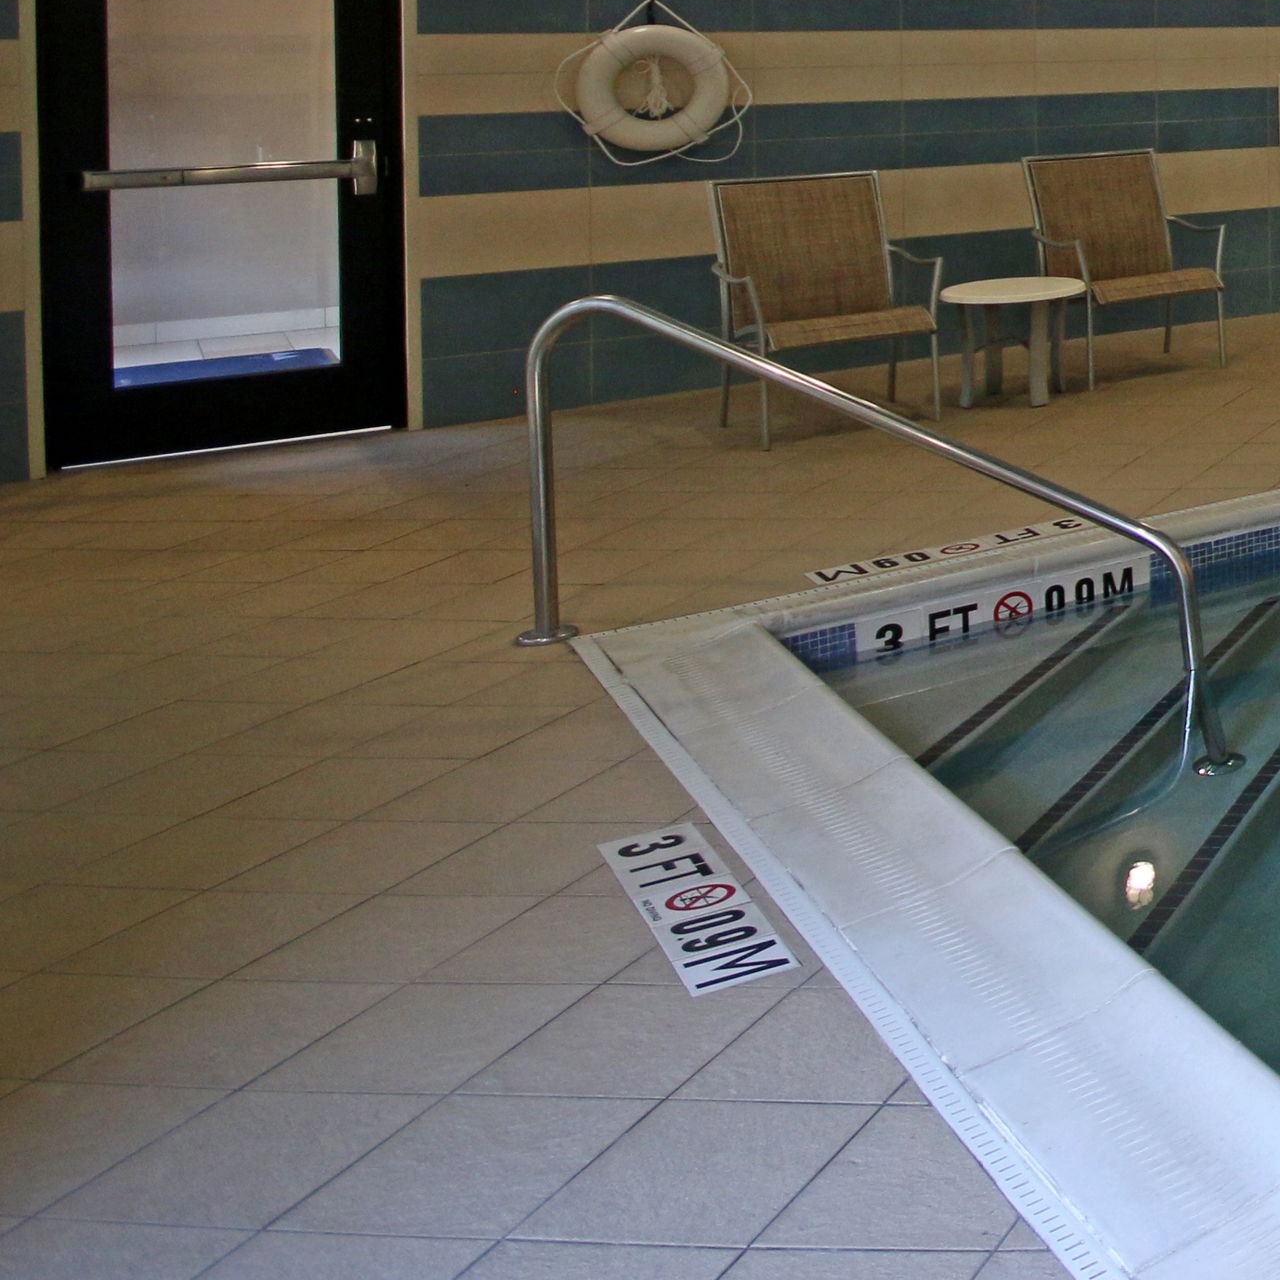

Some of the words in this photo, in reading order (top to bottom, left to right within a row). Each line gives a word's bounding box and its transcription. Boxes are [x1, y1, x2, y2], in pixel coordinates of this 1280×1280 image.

[876, 623, 904, 653] 3
[929, 603, 978, 641] FT
[617, 834, 685, 858] 3
[629, 852, 715, 889] FT
